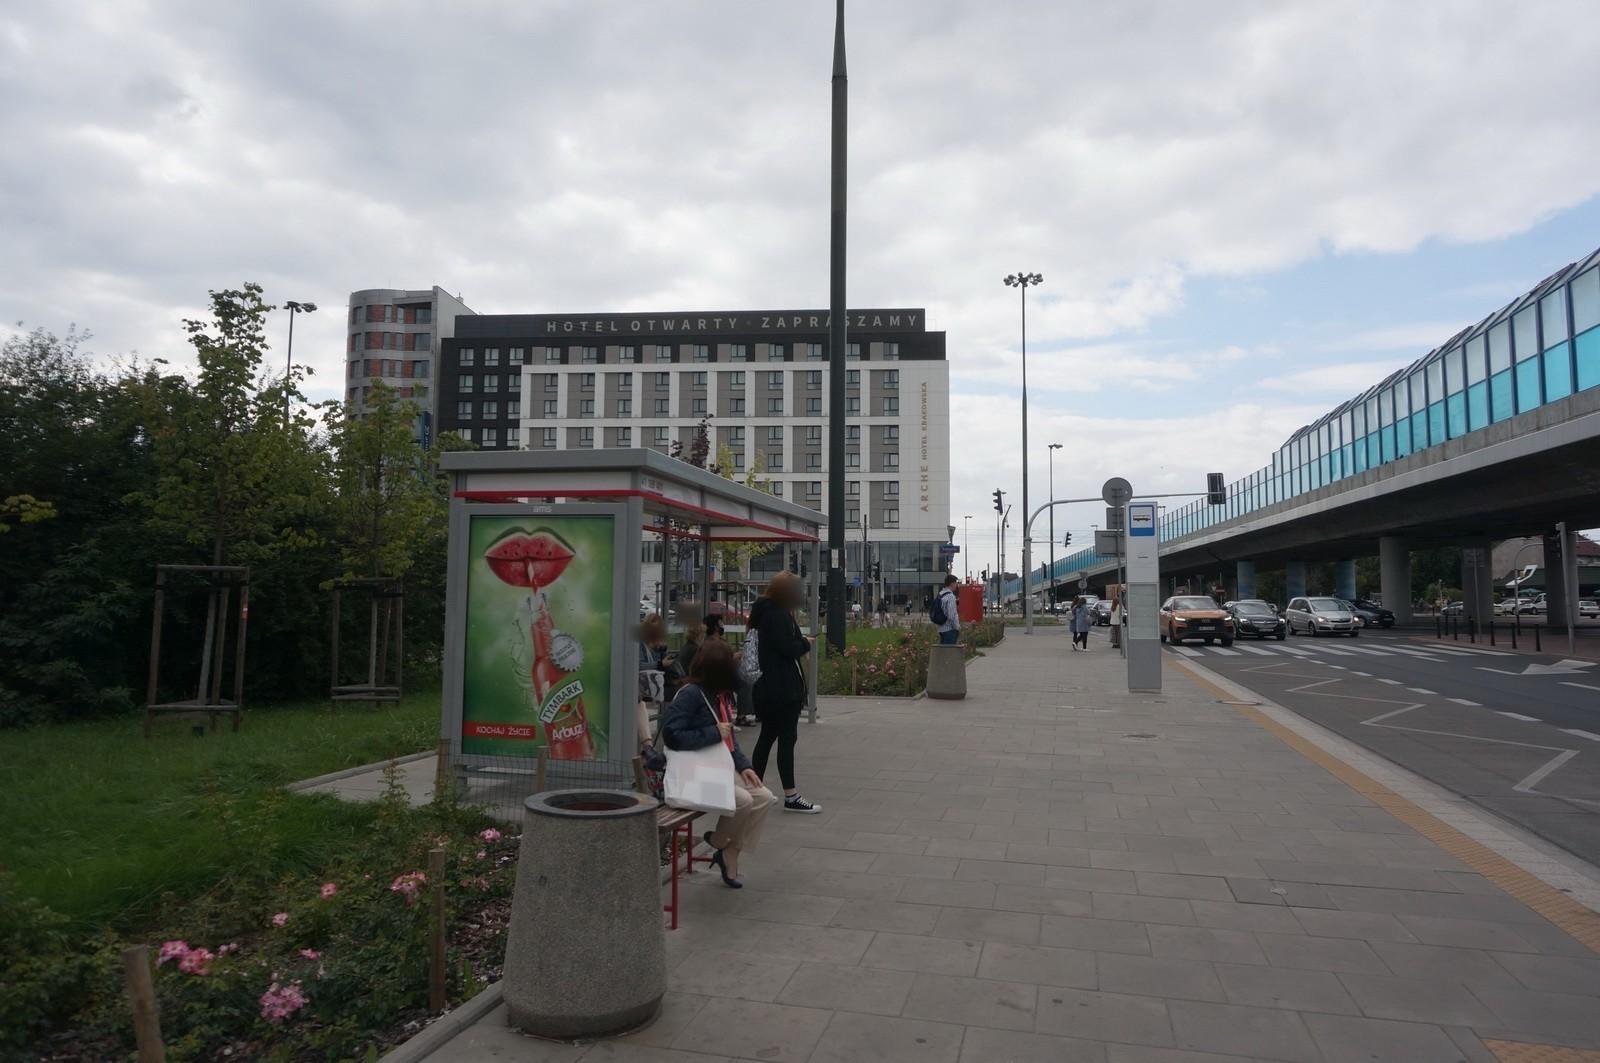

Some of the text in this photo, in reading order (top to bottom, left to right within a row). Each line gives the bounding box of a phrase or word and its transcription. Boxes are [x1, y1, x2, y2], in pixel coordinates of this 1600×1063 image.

[547, 320, 618, 333] HOTEL
[631, 318, 737, 332] OTWARTY
[920, 436, 928, 460] HOTEL
[920, 465, 929, 512] ARCHE
[542, 682, 581, 720] TYMBARK
[475, 726, 505, 735] KOCHAJ
[552, 724, 584, 741] Arbuz
